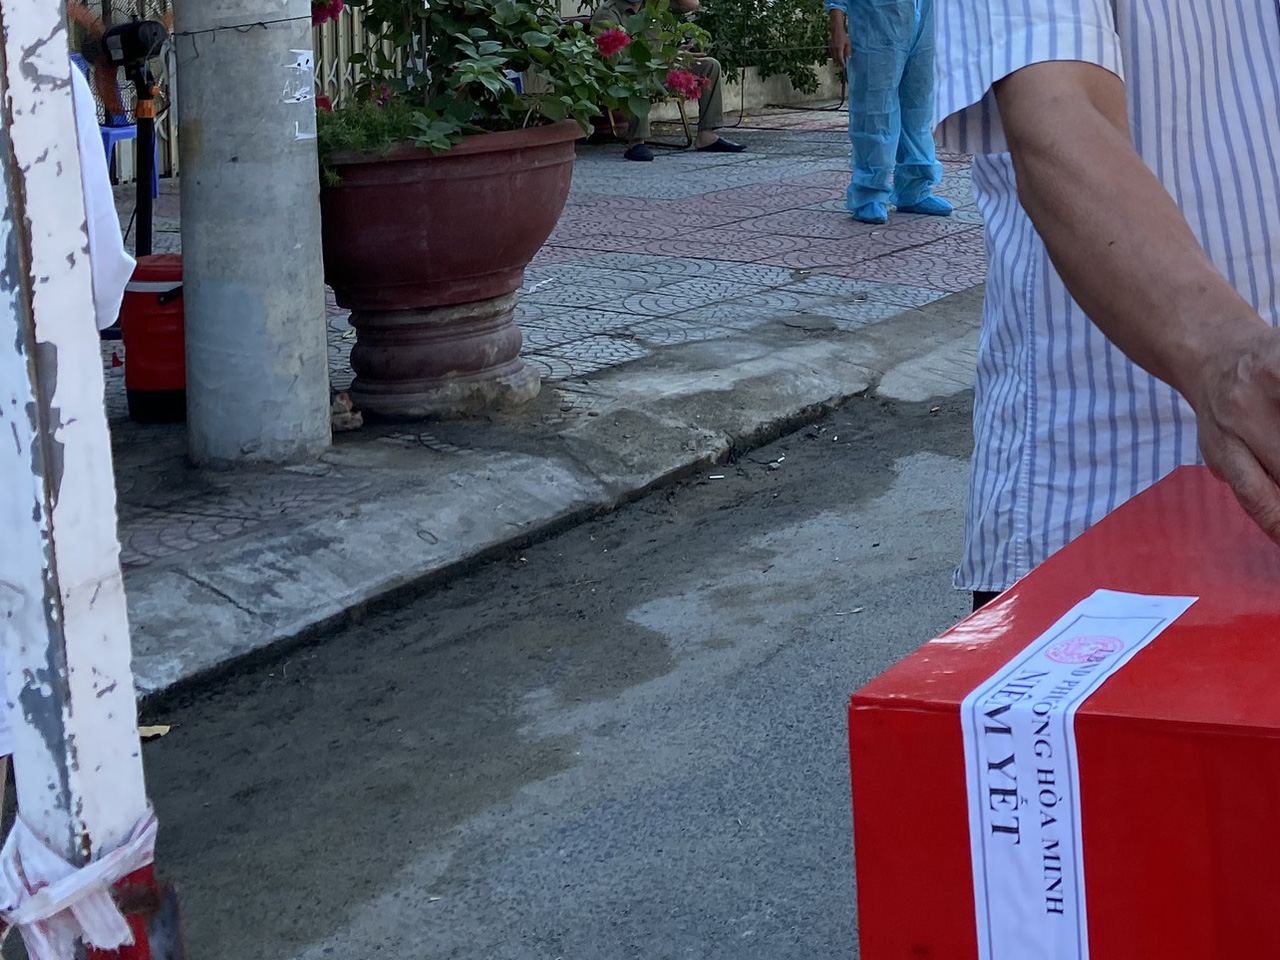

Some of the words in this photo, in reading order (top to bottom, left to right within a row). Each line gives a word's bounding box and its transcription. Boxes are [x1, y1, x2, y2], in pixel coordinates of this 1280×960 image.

[987, 752, 1029, 845] YẾT
[1036, 768, 1064, 829] HÒA
[1041, 838, 1064, 916] MINH
